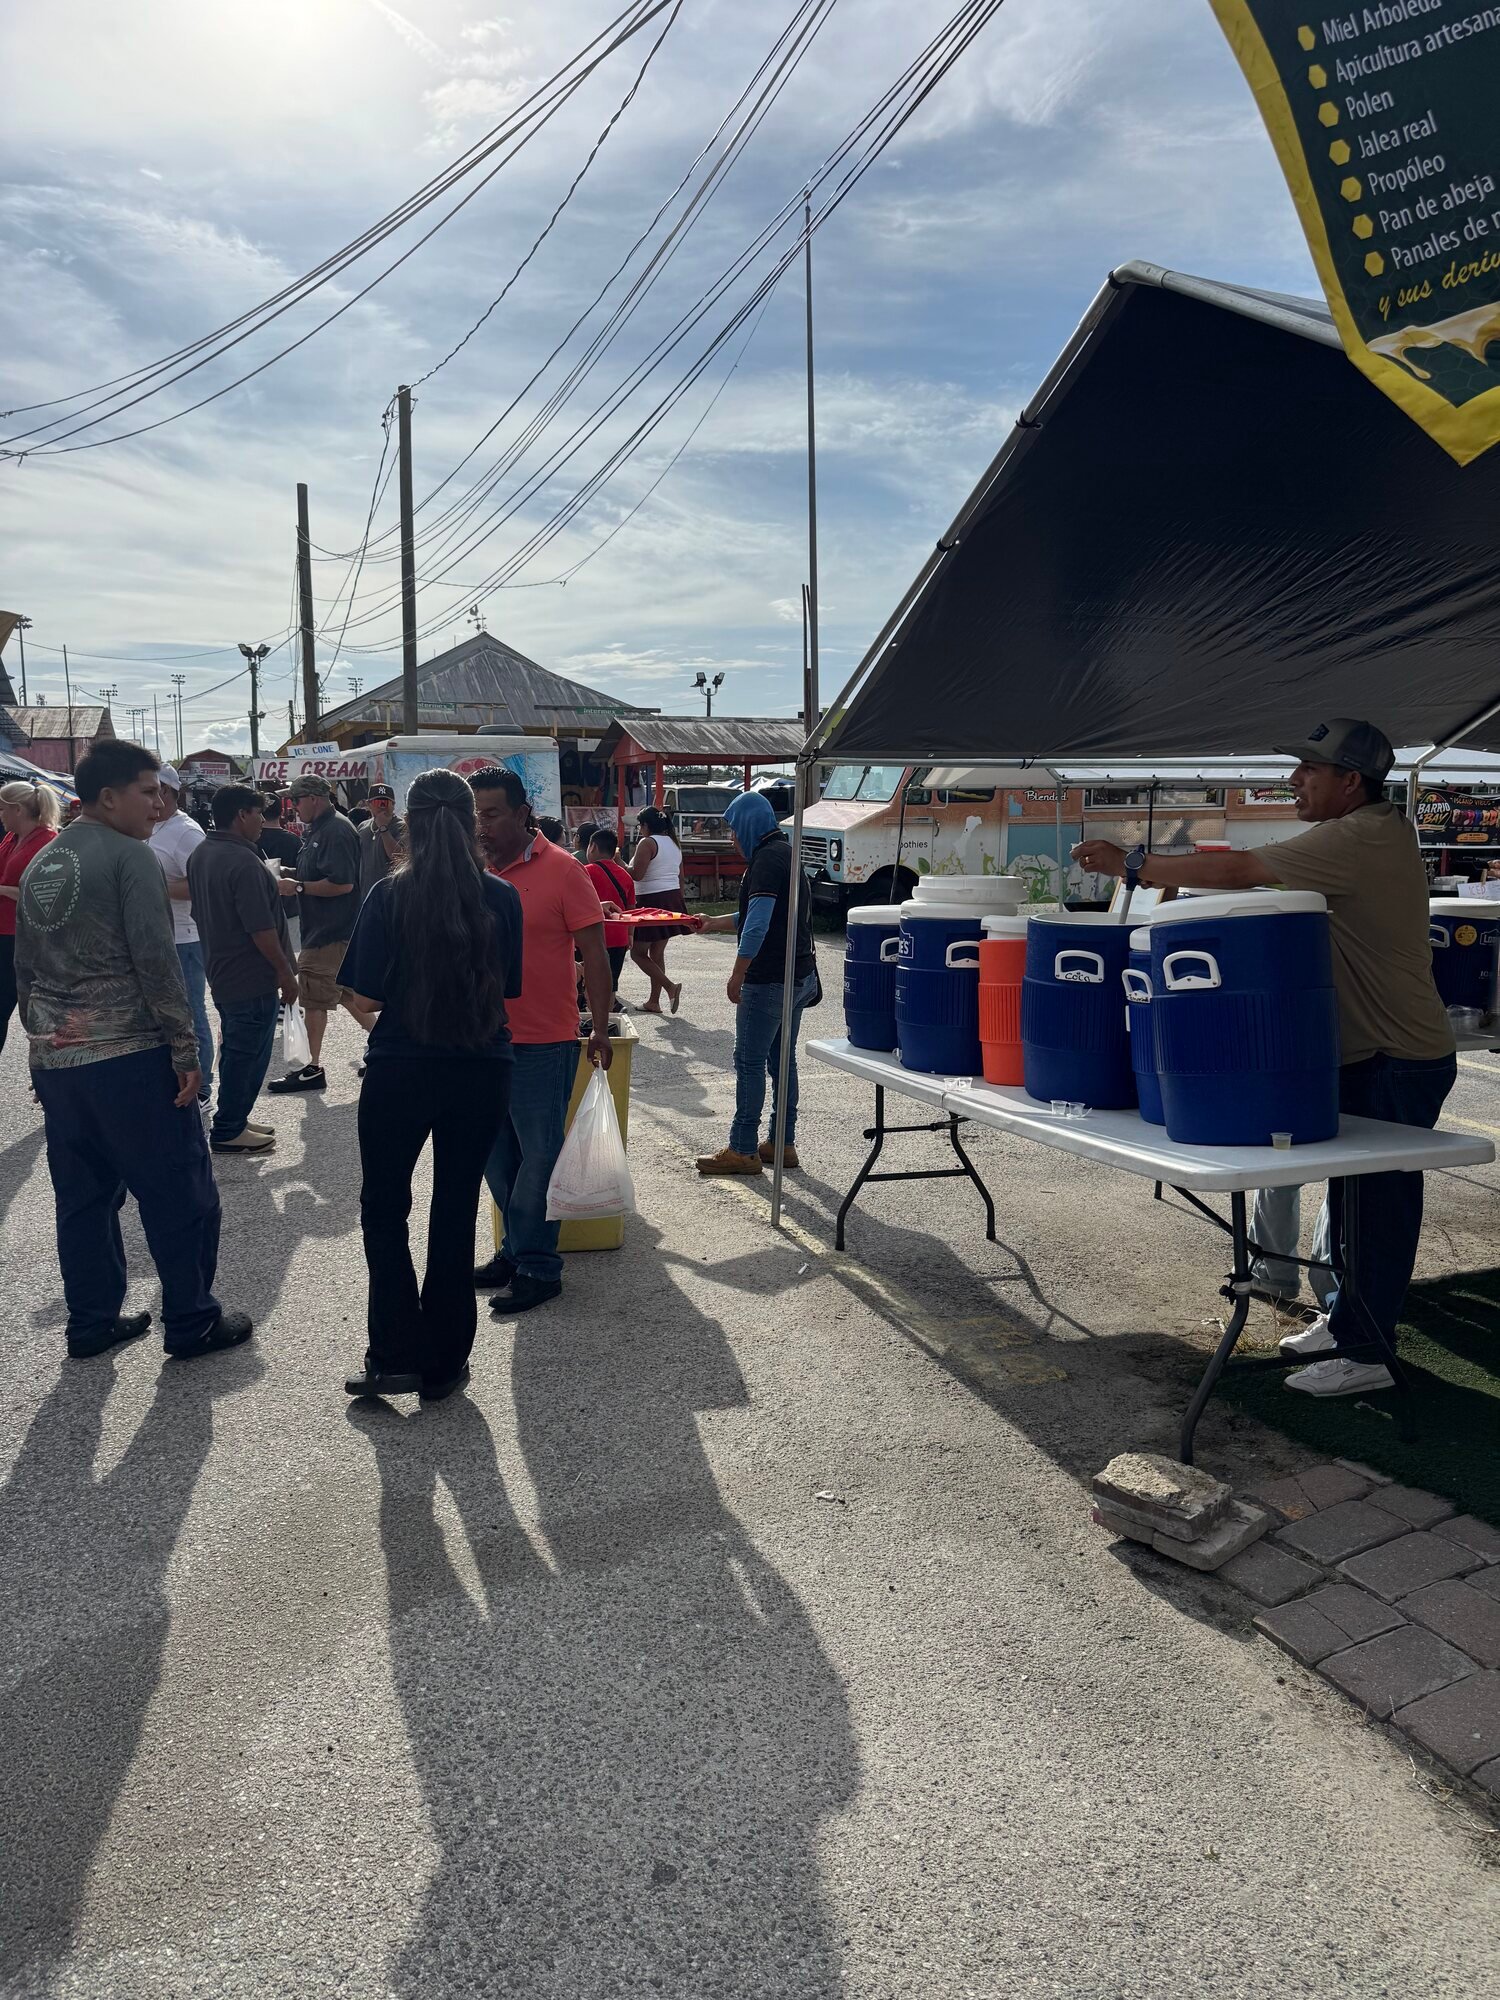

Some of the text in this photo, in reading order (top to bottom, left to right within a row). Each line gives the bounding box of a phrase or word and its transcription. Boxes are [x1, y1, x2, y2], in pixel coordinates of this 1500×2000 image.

[1322, 0, 1442, 45] Miel Arboleda
[1336, 40, 1422, 86] Apicultura
[1345, 91, 1395, 120] Polen
[1358, 109, 1438, 159] Jalea real
[1368, 154, 1446, 196] Propóleo
[1379, 175, 1496, 233] Pan de abeja
[1391, 231, 1461, 270] Panales
[1463, 217, 1489, 241] de
[1379, 296, 1391, 322] y
[1397, 280, 1433, 307] sus
[258, 761, 367, 779] ICE CREAM
[1417, 803, 1450, 815] BARRIO
[1423, 812, 1449, 825] BAY
